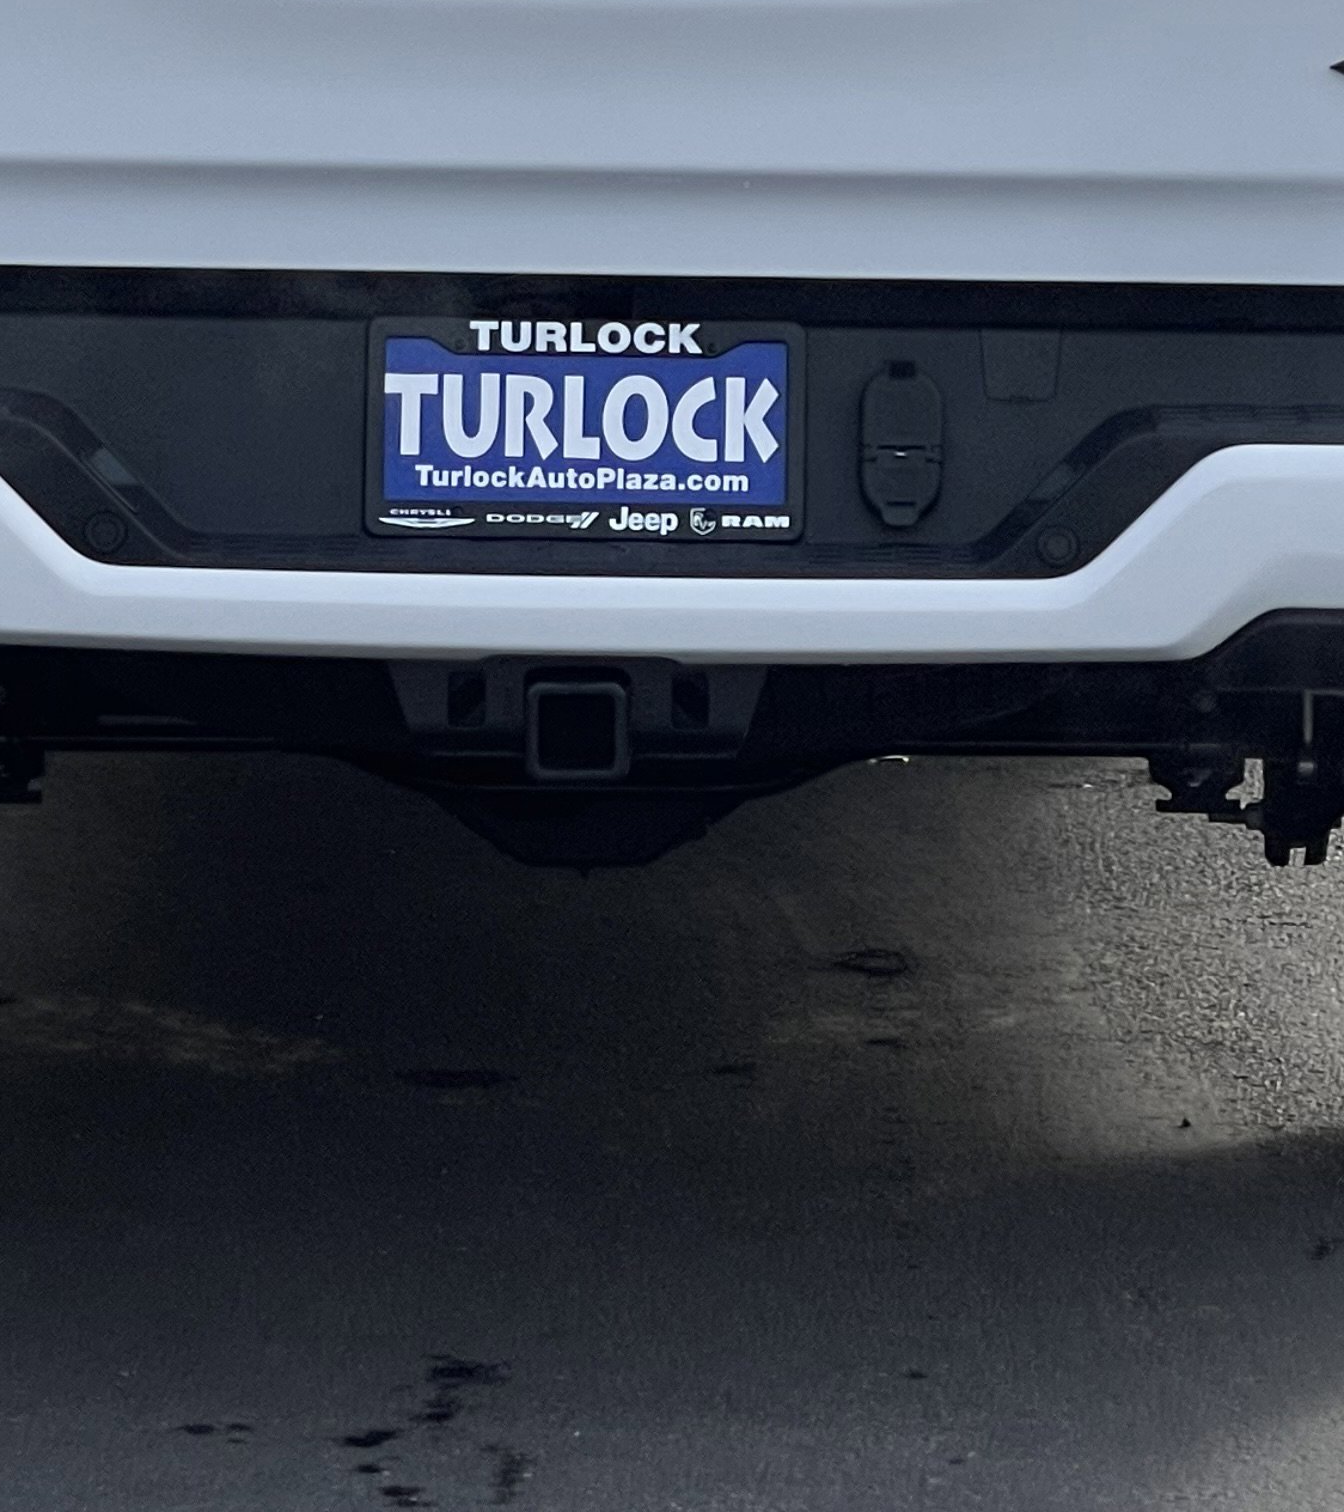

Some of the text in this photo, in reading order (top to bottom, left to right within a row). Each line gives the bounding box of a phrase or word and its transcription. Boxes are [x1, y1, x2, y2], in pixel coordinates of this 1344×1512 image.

[469, 321, 702, 354] TURLOCK
[384, 373, 780, 463] TURLOCK
[415, 464, 749, 492] TurlockAutoPlaza.com
[609, 506, 678, 535] Jeep
[721, 515, 790, 528] RAM
